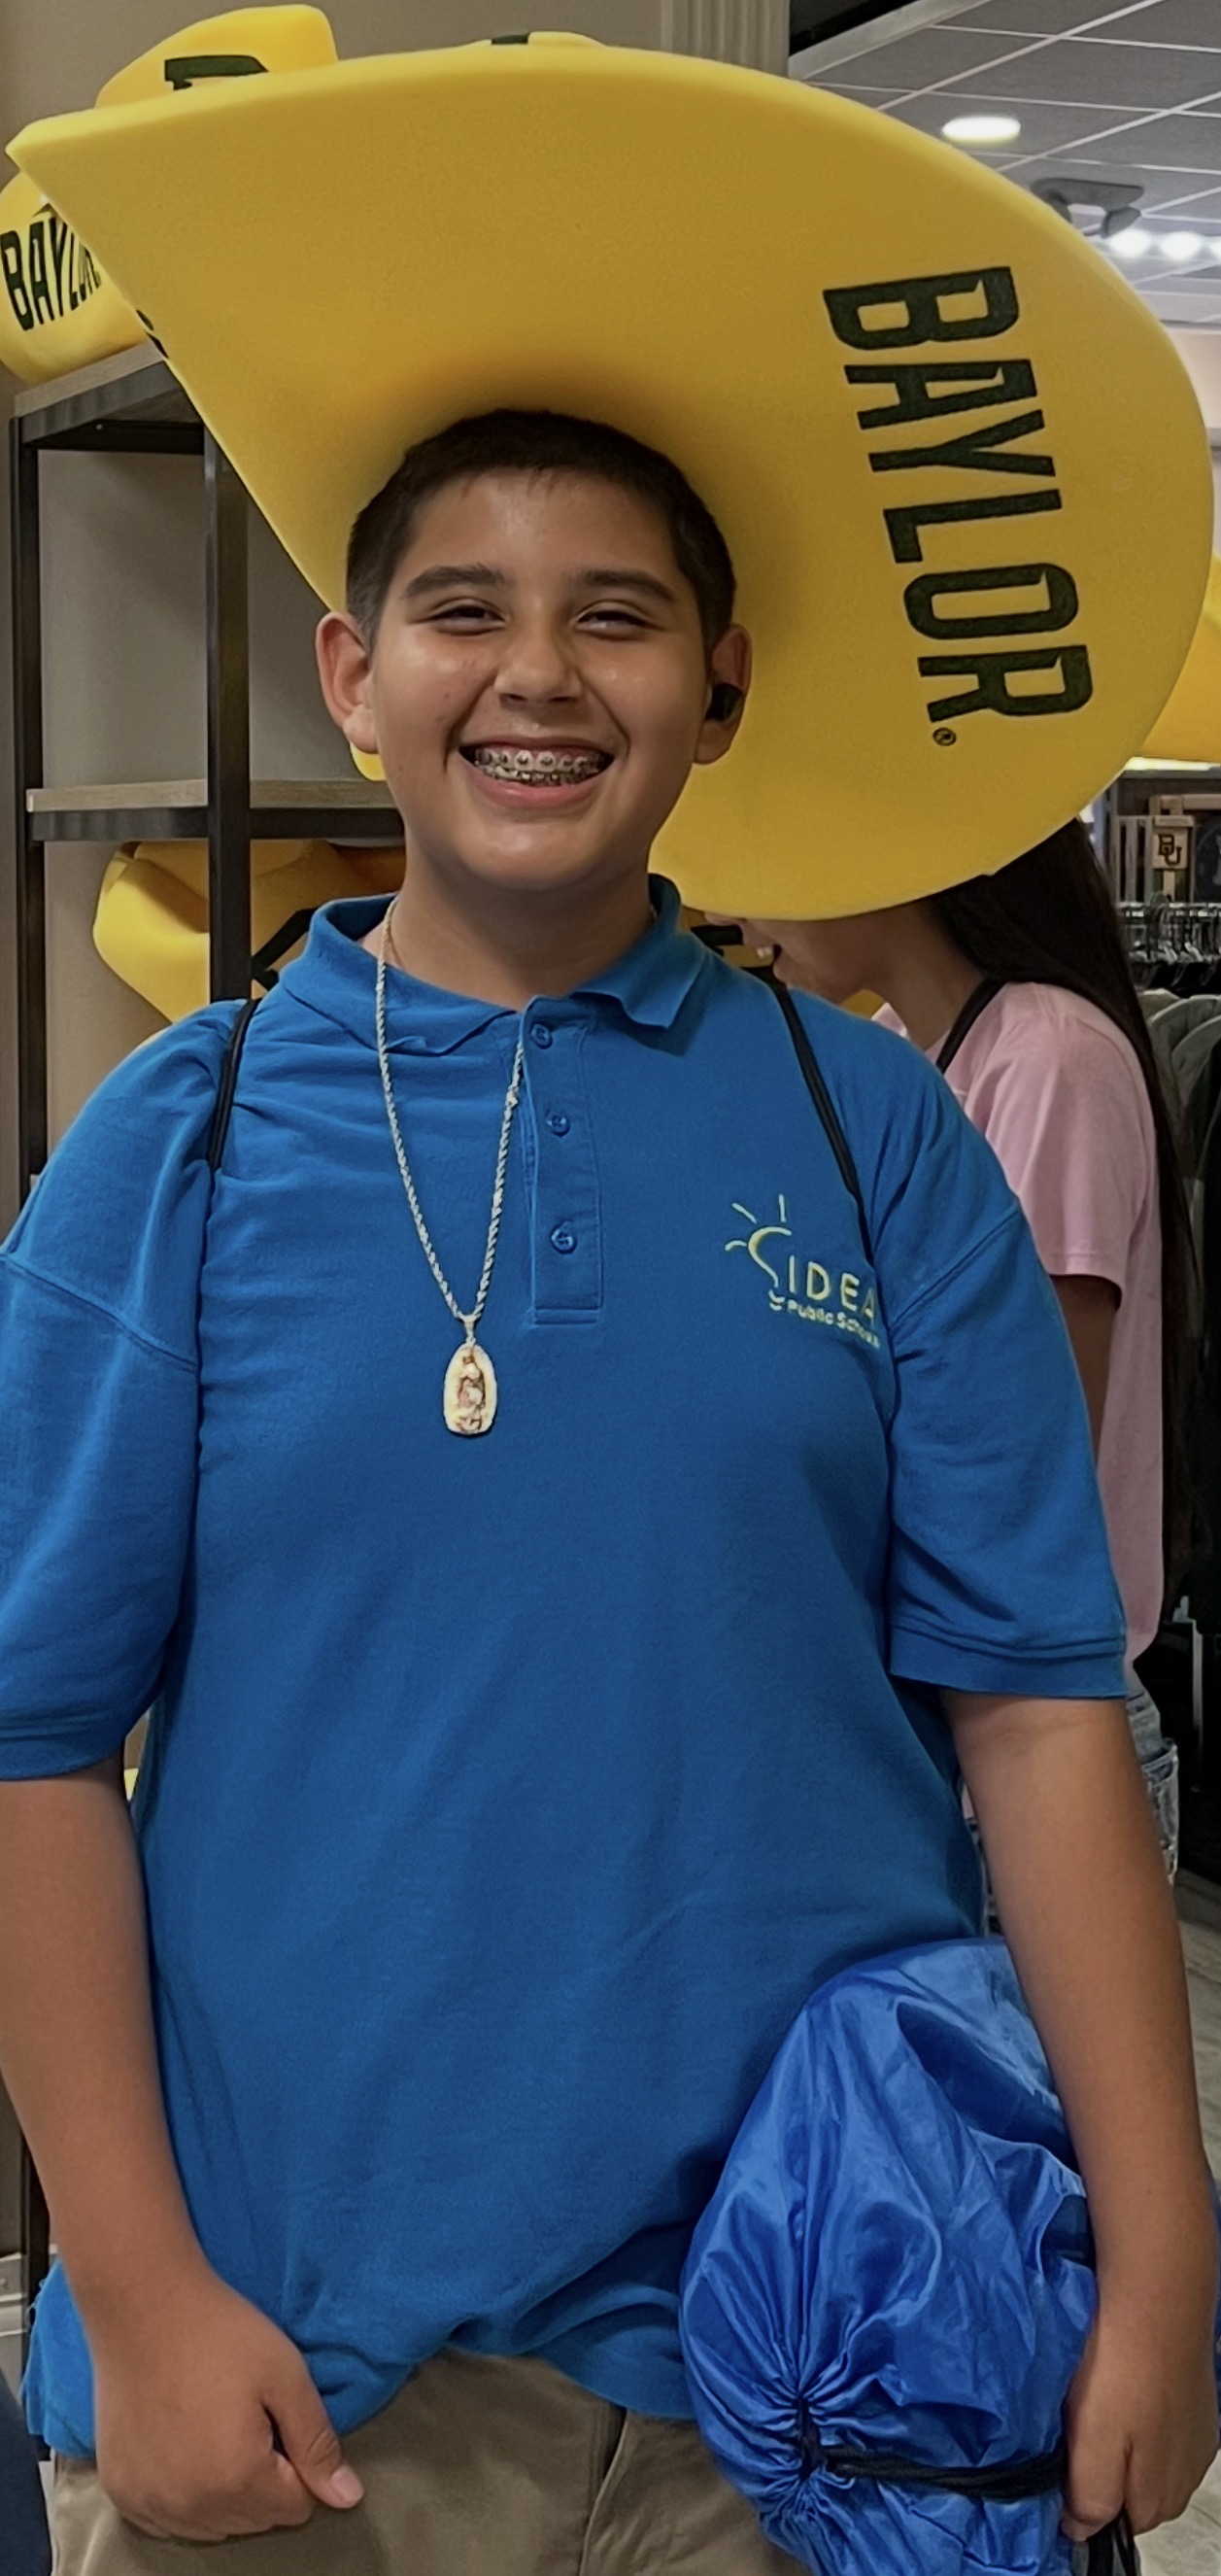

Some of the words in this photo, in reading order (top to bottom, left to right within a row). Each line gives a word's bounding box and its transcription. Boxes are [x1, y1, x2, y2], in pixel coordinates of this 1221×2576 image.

[1158, 834, 1182, 866] BU
[789, 1254, 875, 1329] IDEA
[787, 1298, 834, 1325] Public
